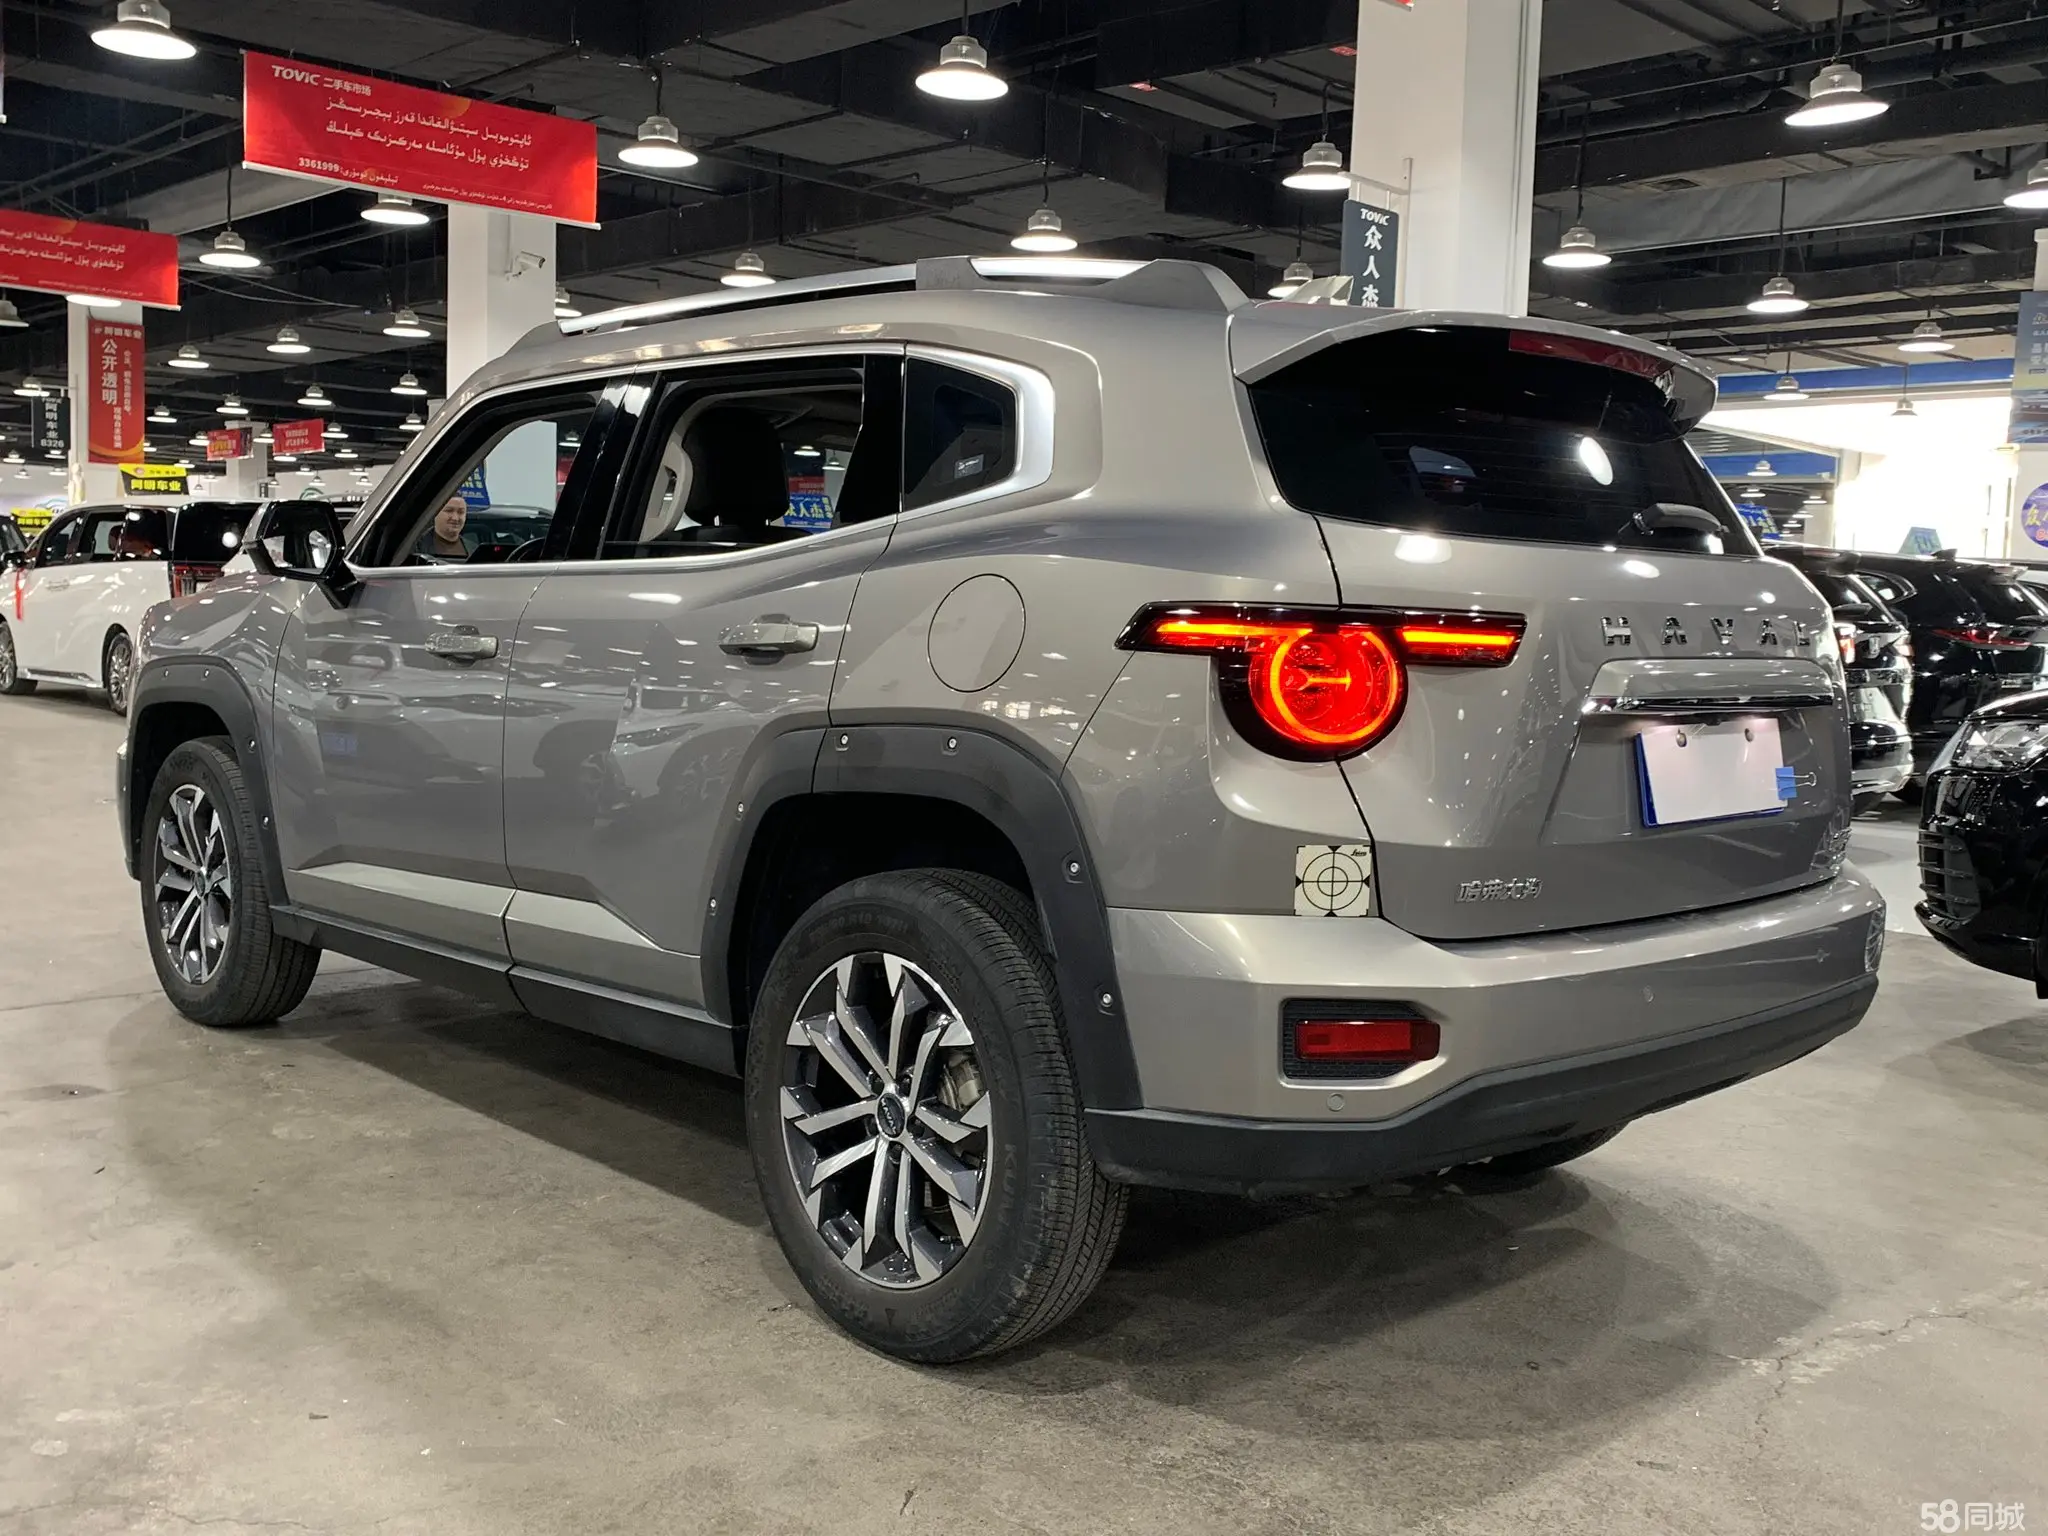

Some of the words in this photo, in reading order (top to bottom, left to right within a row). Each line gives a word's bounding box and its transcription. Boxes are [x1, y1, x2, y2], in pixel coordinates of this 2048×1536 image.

[272, 64, 321, 86] TOVIC
[323, 77, 372, 96] 二手车市场
[298, 157, 339, 173] 3361999
[1360, 208, 1390, 226] TOVIC
[102, 339, 118, 405] 公开透明
[1601, 615, 1810, 647] HAVAL
